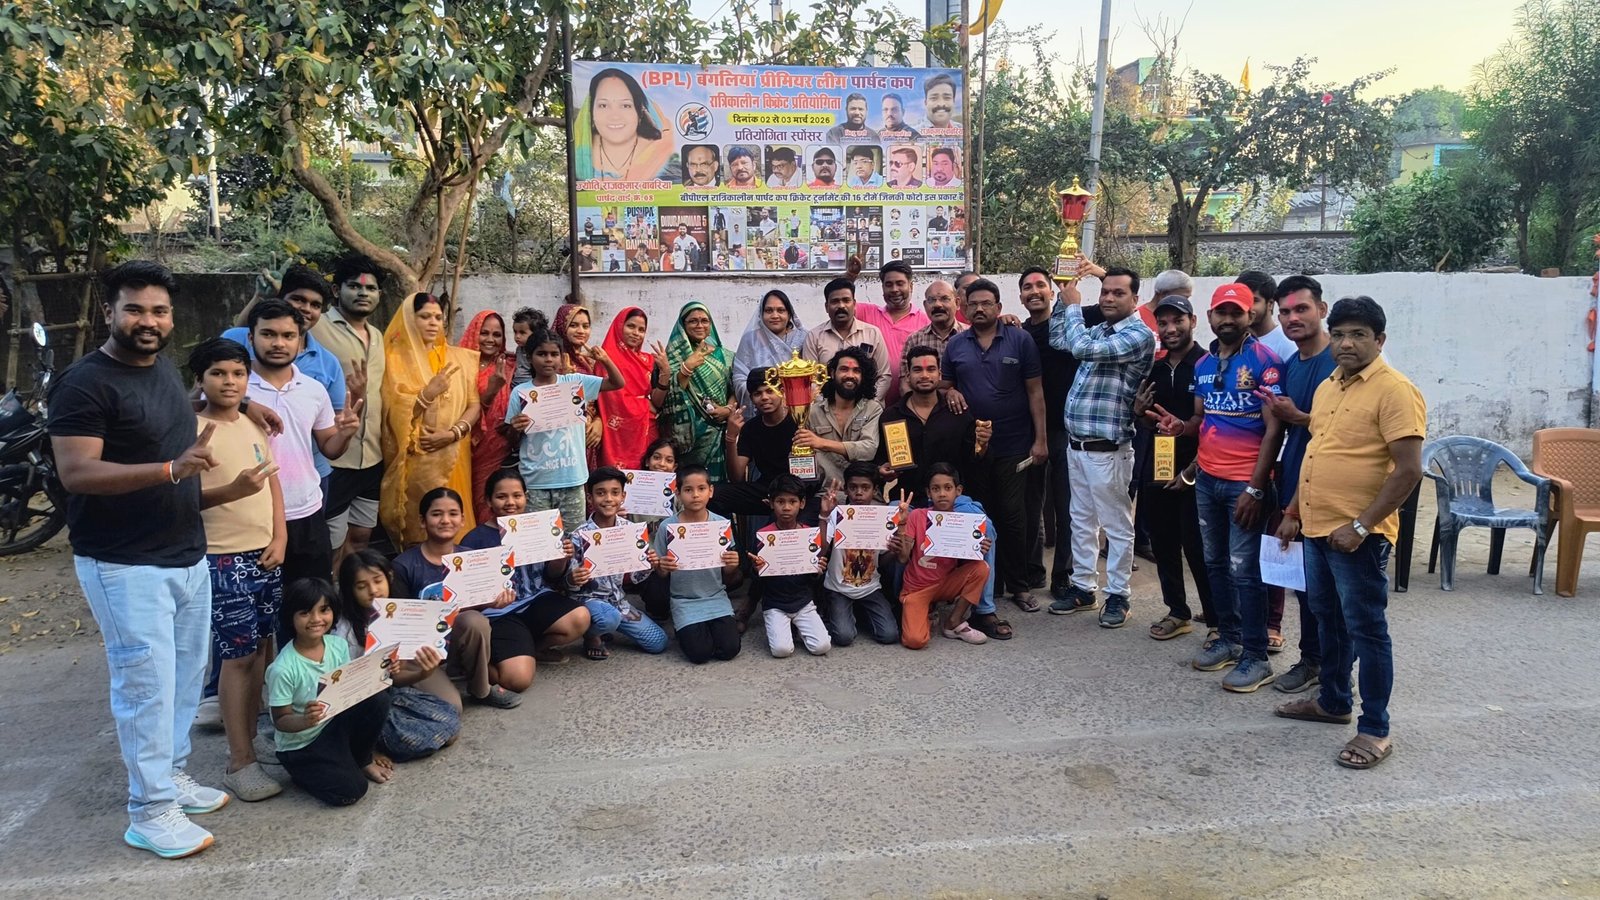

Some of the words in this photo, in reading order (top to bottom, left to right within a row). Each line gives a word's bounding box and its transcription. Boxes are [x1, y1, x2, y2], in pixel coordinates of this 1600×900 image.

[641, 70, 692, 89] (BPL)
[760, 70, 813, 89] प्रीमियर
[816, 71, 847, 89] लीग
[851, 71, 887, 89] पार्षद
[890, 75, 915, 89] कप
[709, 92, 760, 109] रात्रिकालीन
[791, 92, 842, 110] प्रतियोगिता
[733, 113, 759, 123] दिनांक
[772, 114, 779, 123] से
[793, 114, 808, 123] मार्च
[810, 116, 830, 124] 2026
[734, 127, 787, 141] प्रतियोगिता
[711, 192, 753, 202] रात्रिकालीन
[755, 192, 773, 202] पार्षद
[775, 194, 788, 202] कप
[840, 192, 851, 201] की
[878, 192, 904, 201] जिनकी
[906, 192, 923, 201] फोटो
[924, 193, 936, 201] इस
[938, 193, 957, 201] प्रकार
[702, 215, 707, 227] 5
[1204, 391, 1254, 407] ATAR
